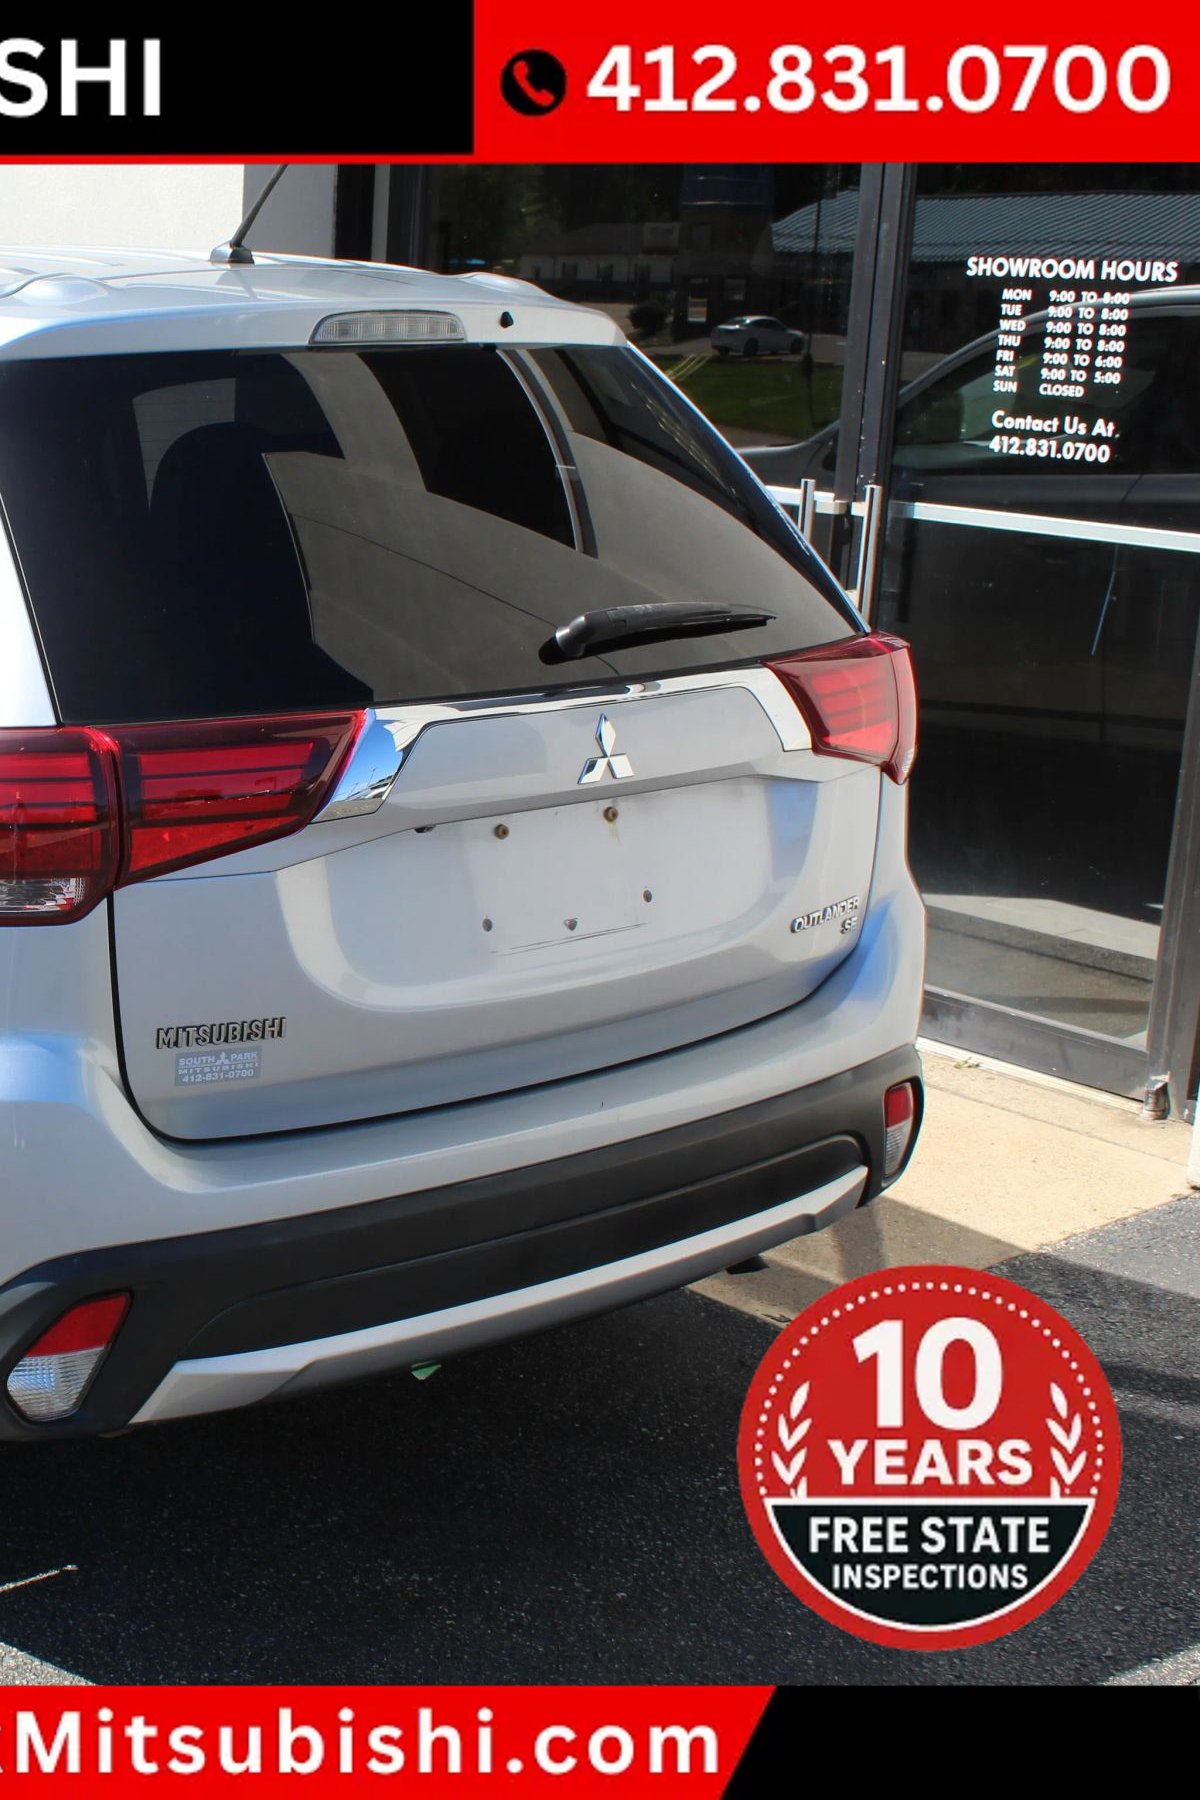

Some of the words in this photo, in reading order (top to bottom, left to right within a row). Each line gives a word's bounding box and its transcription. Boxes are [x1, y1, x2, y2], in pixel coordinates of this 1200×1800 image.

[966, 257, 1095, 279] SHOWROOM
[1101, 260, 1179, 282] HOURS
[1002, 289, 1032, 300] MON
[1049, 290, 1076, 302] 9:00
[1081, 291, 1097, 303] TO
[1103, 292, 1130, 305] 8:00
[1001, 304, 1022, 316] TUE
[1047, 306, 1073, 318] 9:00
[1078, 307, 1095, 319] TO
[1101, 308, 1129, 321] 8:00
[1000, 320, 1026, 331] WED
[1046, 322, 1071, 334] 9:00
[1077, 323, 1093, 335] TO
[1098, 324, 1126, 337] 8:00
[998, 335, 1021, 347] THU
[1044, 337, 1070, 350] 9:00
[1075, 338, 1092, 351] TO
[1097, 340, 1125, 352] 8:00
[996, 350, 1014, 362] FRI
[1042, 352, 1068, 365] 9:00
[1073, 354, 1090, 366] TO
[1095, 355, 1123, 368] 6:00
[994, 365, 1016, 377] SAT
[1040, 368, 1066, 381] 9:00
[1070, 369, 1087, 382] TO
[1093, 371, 1121, 384] 5:00
[993, 381, 1017, 393] SUN
[1039, 383, 1084, 397] CLOSED
[991, 410, 1059, 433] Contact
[1063, 415, 1087, 436] Us
[989, 436, 1110, 463] 412.831.0700
[790, 896, 860, 933] OUTLANDER
[841, 916, 858, 934] SE
[156, 1017, 286, 1049] MITSUBISHI
[179, 1055, 216, 1066] SOUTH
[230, 1052, 258, 1062] PARK
[178, 1062, 259, 1075] MITSUBISHI
[182, 1068, 254, 1083] 412-831-0700
